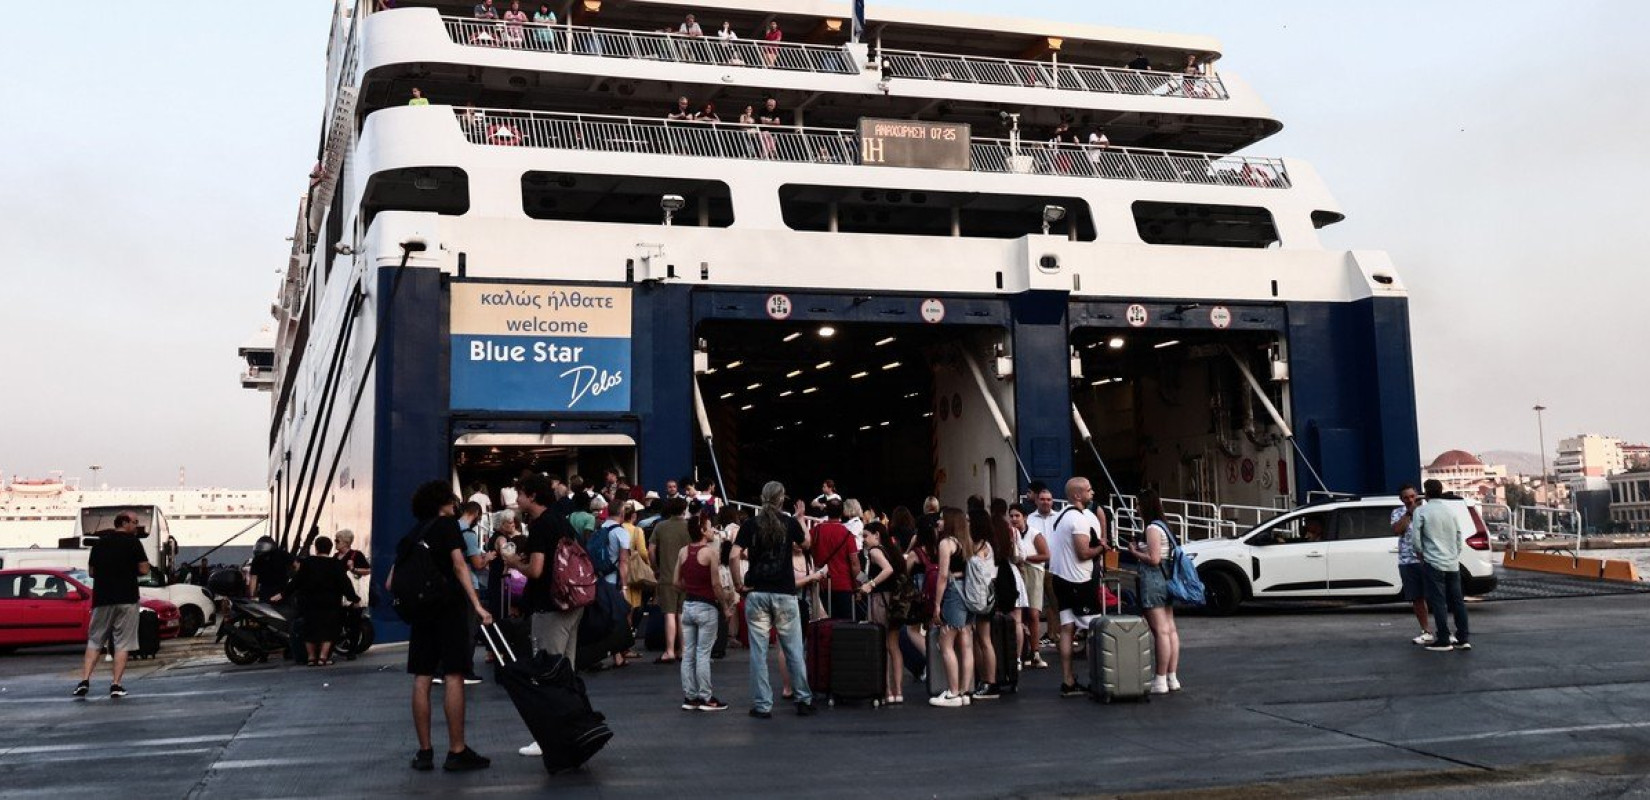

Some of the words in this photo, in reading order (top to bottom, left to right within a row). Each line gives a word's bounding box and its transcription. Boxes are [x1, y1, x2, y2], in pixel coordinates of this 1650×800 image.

[481, 290, 541, 308] καλώς
[548, 291, 614, 311] ήλθατε
[507, 316, 588, 333] welcome
[470, 340, 526, 361] Blue
[533, 341, 584, 363] Star
[559, 365, 622, 408] Delos
